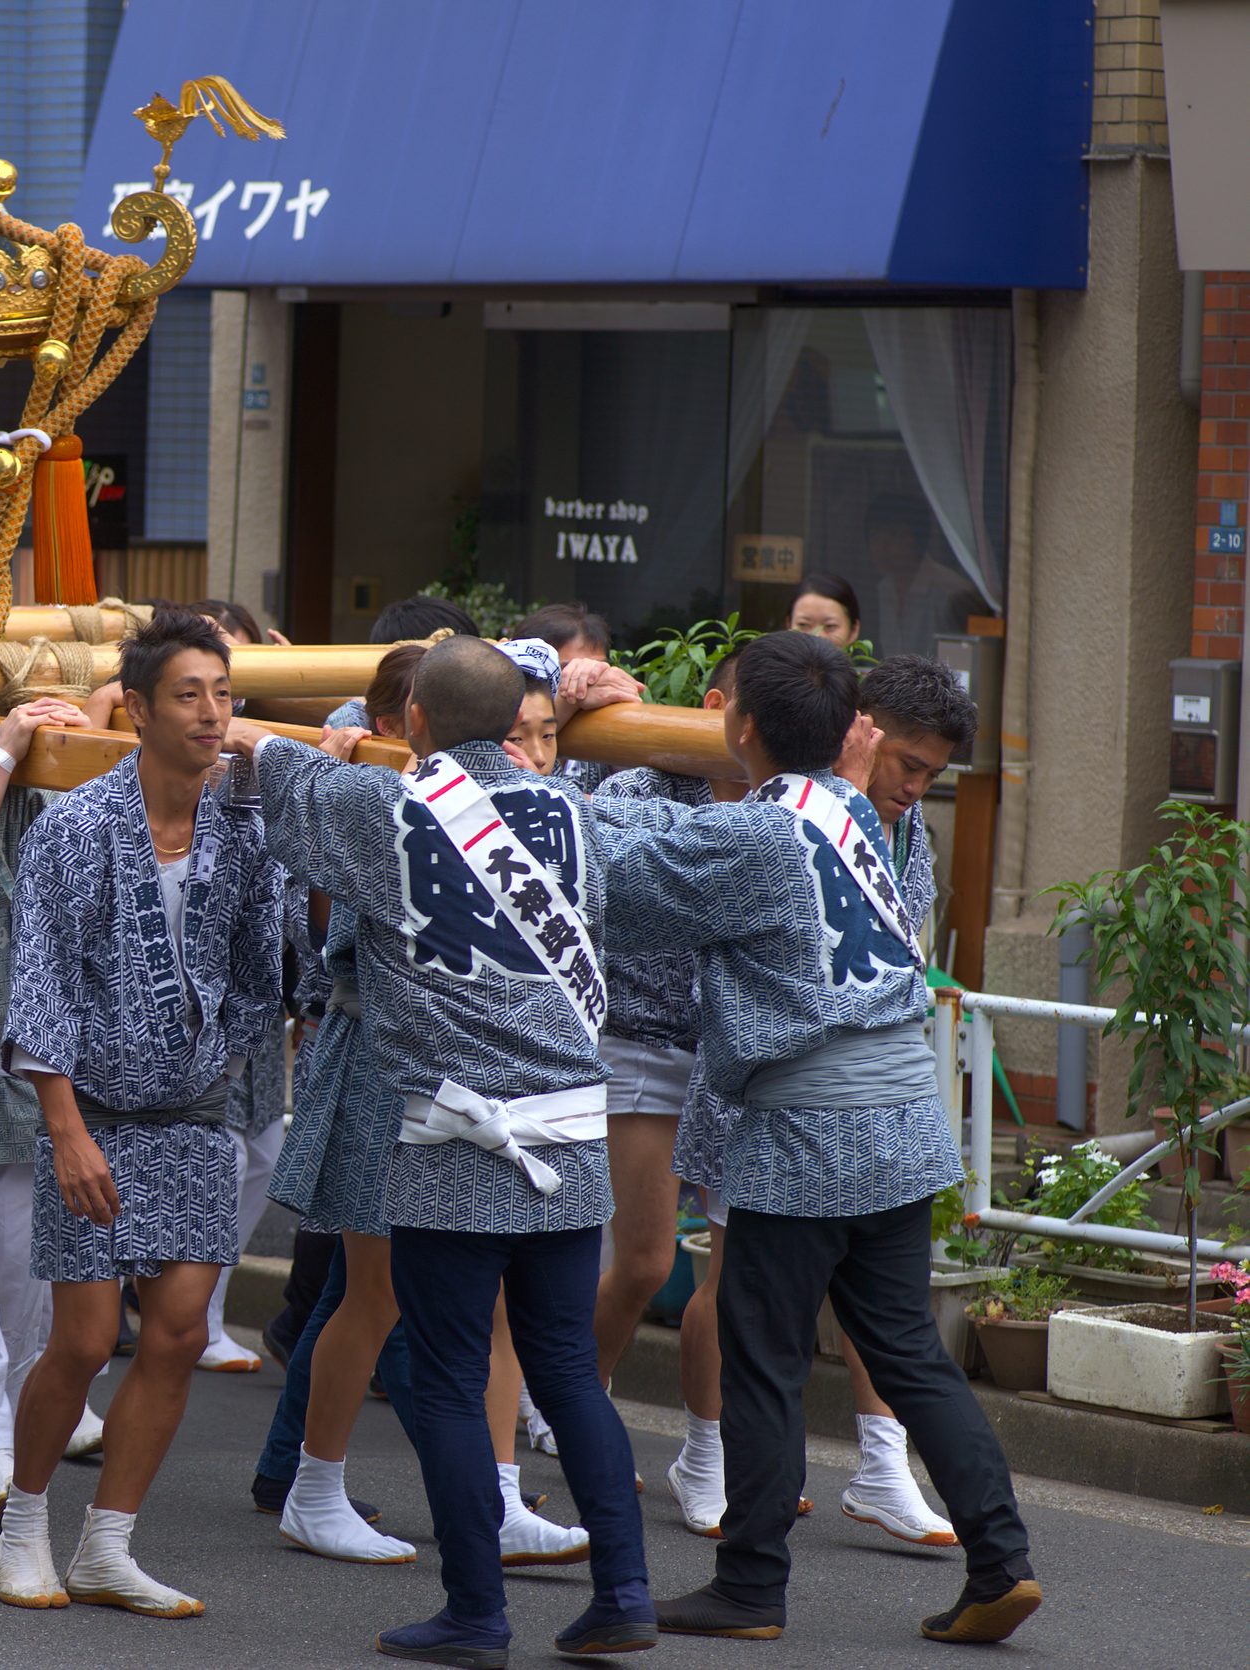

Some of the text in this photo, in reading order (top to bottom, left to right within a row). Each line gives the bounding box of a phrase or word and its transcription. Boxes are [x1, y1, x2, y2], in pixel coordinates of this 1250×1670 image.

[545, 496, 648, 525] barber shop
[556, 532, 638, 563] IWAYA
[1213, 533, 1241, 549] 2-10
[131, 880, 190, 1053] 東駒形二丁目
